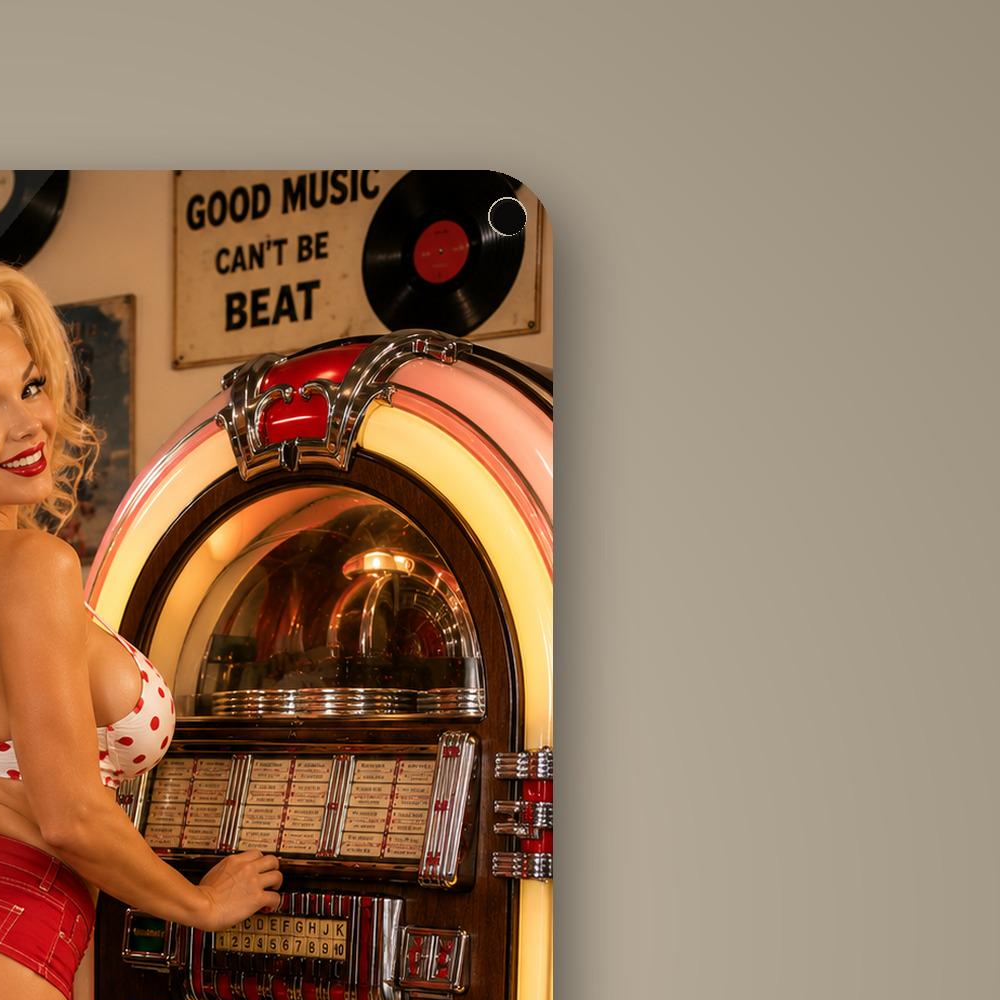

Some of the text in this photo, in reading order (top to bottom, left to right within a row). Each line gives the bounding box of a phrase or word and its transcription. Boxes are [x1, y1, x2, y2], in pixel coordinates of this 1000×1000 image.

[186, 170, 380, 231] GOOD MUSIC
[215, 231, 329, 275] CAN'T BE
[225, 279, 321, 332] BEAT
